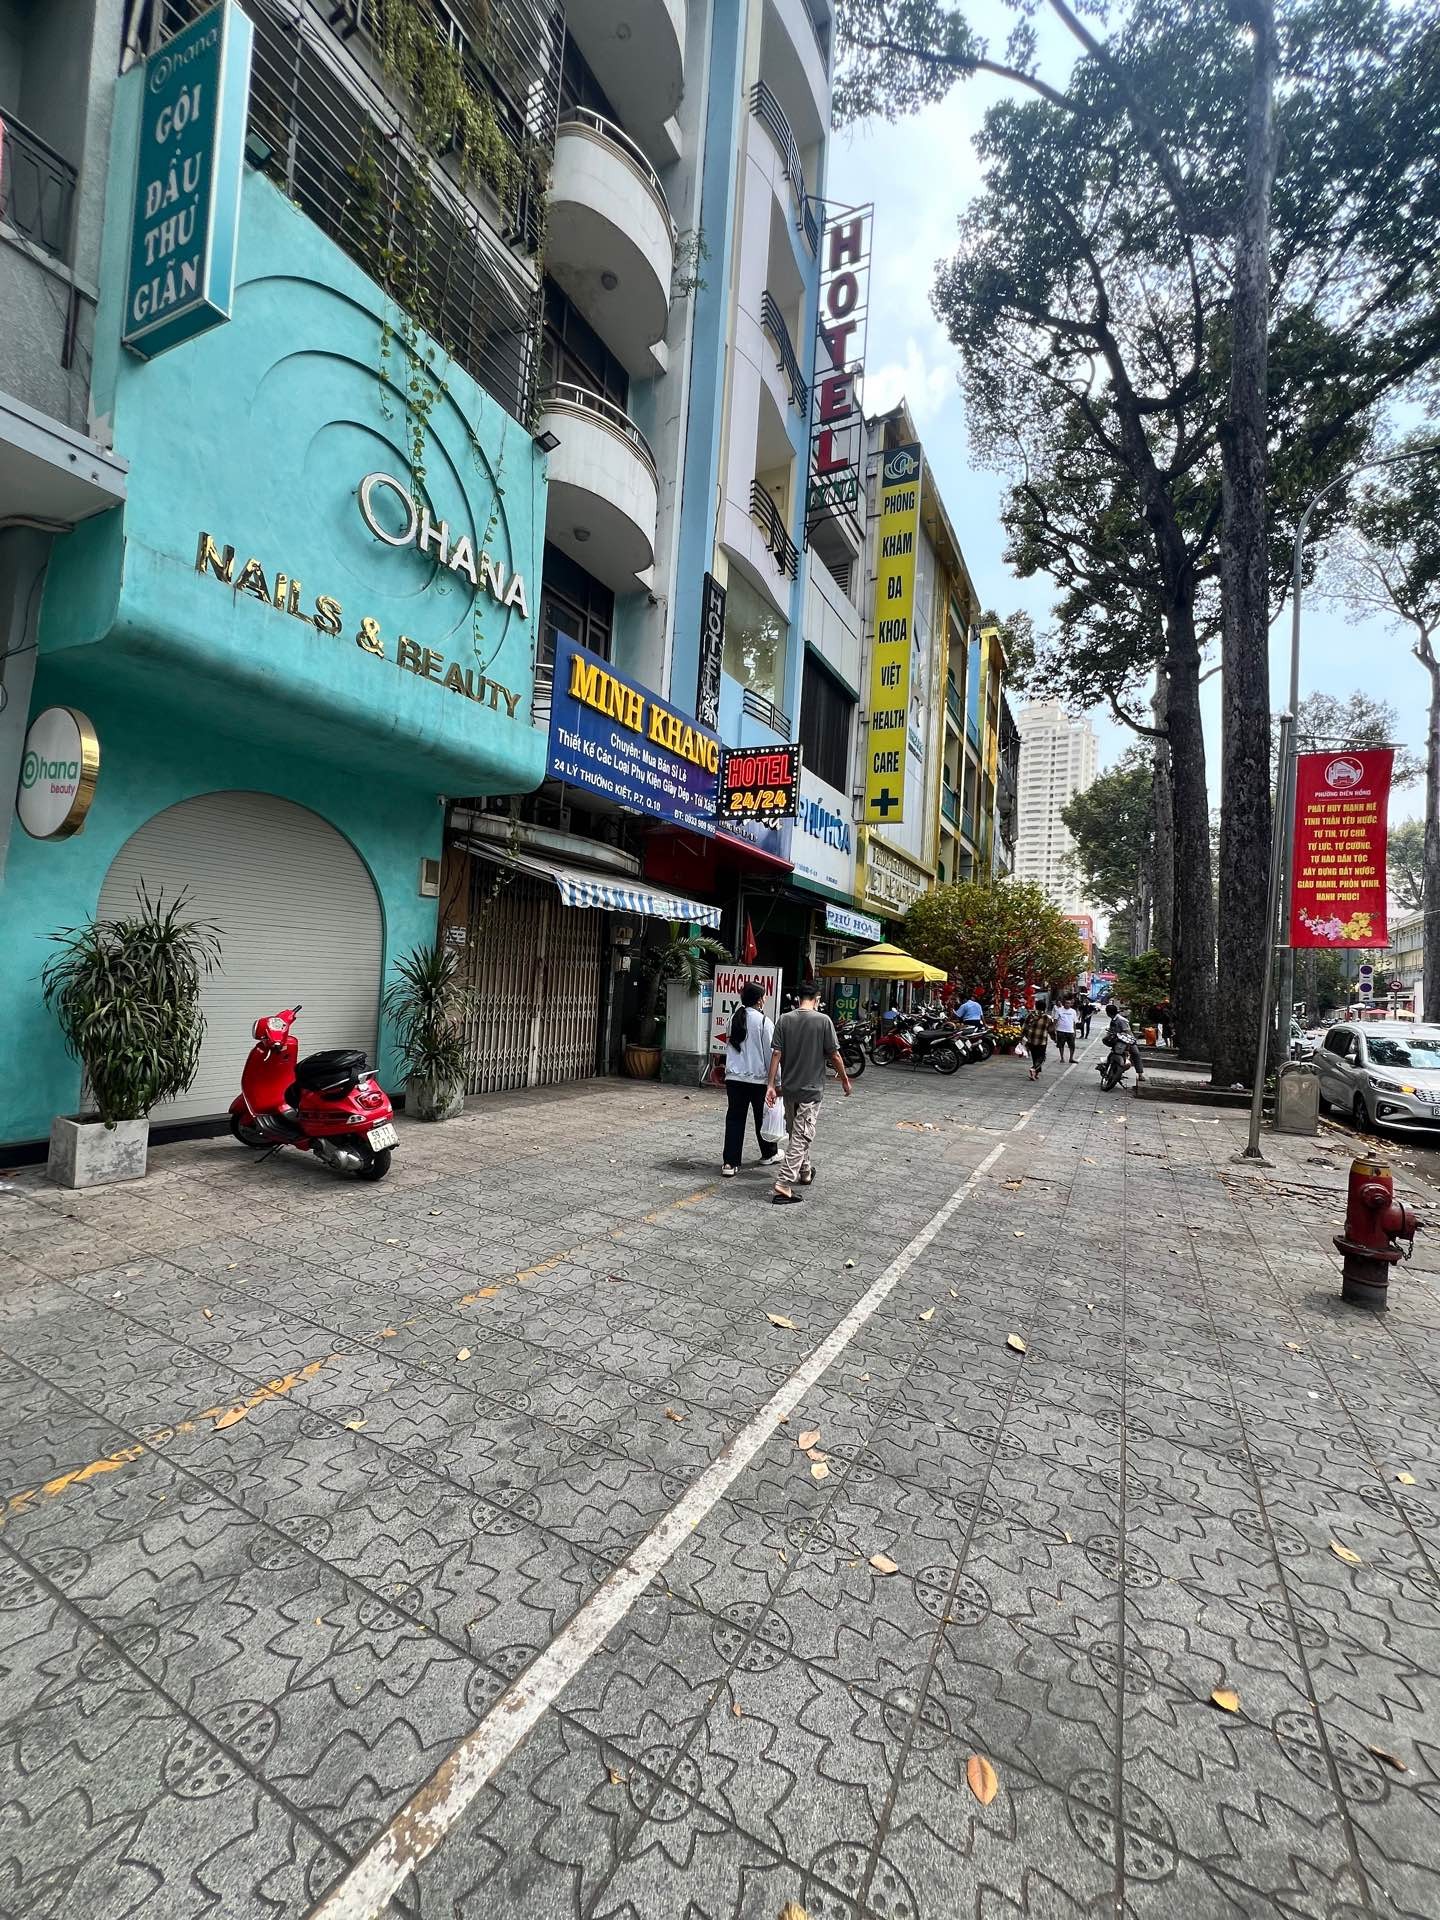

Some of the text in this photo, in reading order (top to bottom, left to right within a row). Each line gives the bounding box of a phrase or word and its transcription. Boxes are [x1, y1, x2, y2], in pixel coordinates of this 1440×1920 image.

[151, 28, 218, 93] Ohana
[155, 84, 202, 144] GỘI
[144, 148, 202, 219] ĐẦU
[144, 193, 199, 266] THƯ
[133, 255, 200, 321] GIÃN
[817, 216, 863, 475] HOTEL
[883, 489, 915, 516] PHÒNG
[358, 471, 529, 619] OHANA
[882, 529, 913, 559] KHÁM
[195, 531, 343, 636] NAILS
[887, 575, 903, 600] ĐA
[356, 617, 384, 659] &
[703, 588, 722, 698] HOTEL
[878, 618, 907, 644] KHOA
[396, 634, 522, 720] BEAUTY
[881, 661, 902, 690] VIỆT
[569, 653, 719, 774] MINH KHANG
[872, 708, 905, 731] HEALTH
[22, 751, 79, 790] Ohana
[558, 727, 582, 752] Thiết
[583, 740, 597, 758] Kế
[597, 747, 613, 766] Các
[613, 755, 631, 776] Loại
[631, 763, 646, 784] Phụ
[647, 770, 662, 790] Kiện
[663, 779, 678, 798] Giày
[678, 785, 690, 804] Dép
[611, 732, 641, 760] Chuyên:
[642, 749, 657, 768] Mua
[657, 757, 671, 775] Bán
[728, 754, 792, 788] HOTEL
[873, 751, 900, 774] CARE
[50, 783, 76, 797] beauty
[554, 758, 661, 812] 24 LÝ THƯỜNG KIỆT, P.7, Q.10
[730, 790, 787, 811] 24/24
[1304, 817, 1321, 826] TINH
[1342, 815, 1356, 825] YÊU
[1326, 803, 1342, 813] HUY
[1354, 853, 1369, 864] TỘC
[827, 910, 851, 927] PHÚ
[853, 918, 873, 934] HÒA
[835, 998, 859, 1010] GIỮ
[836, 1010, 853, 1021] XE
